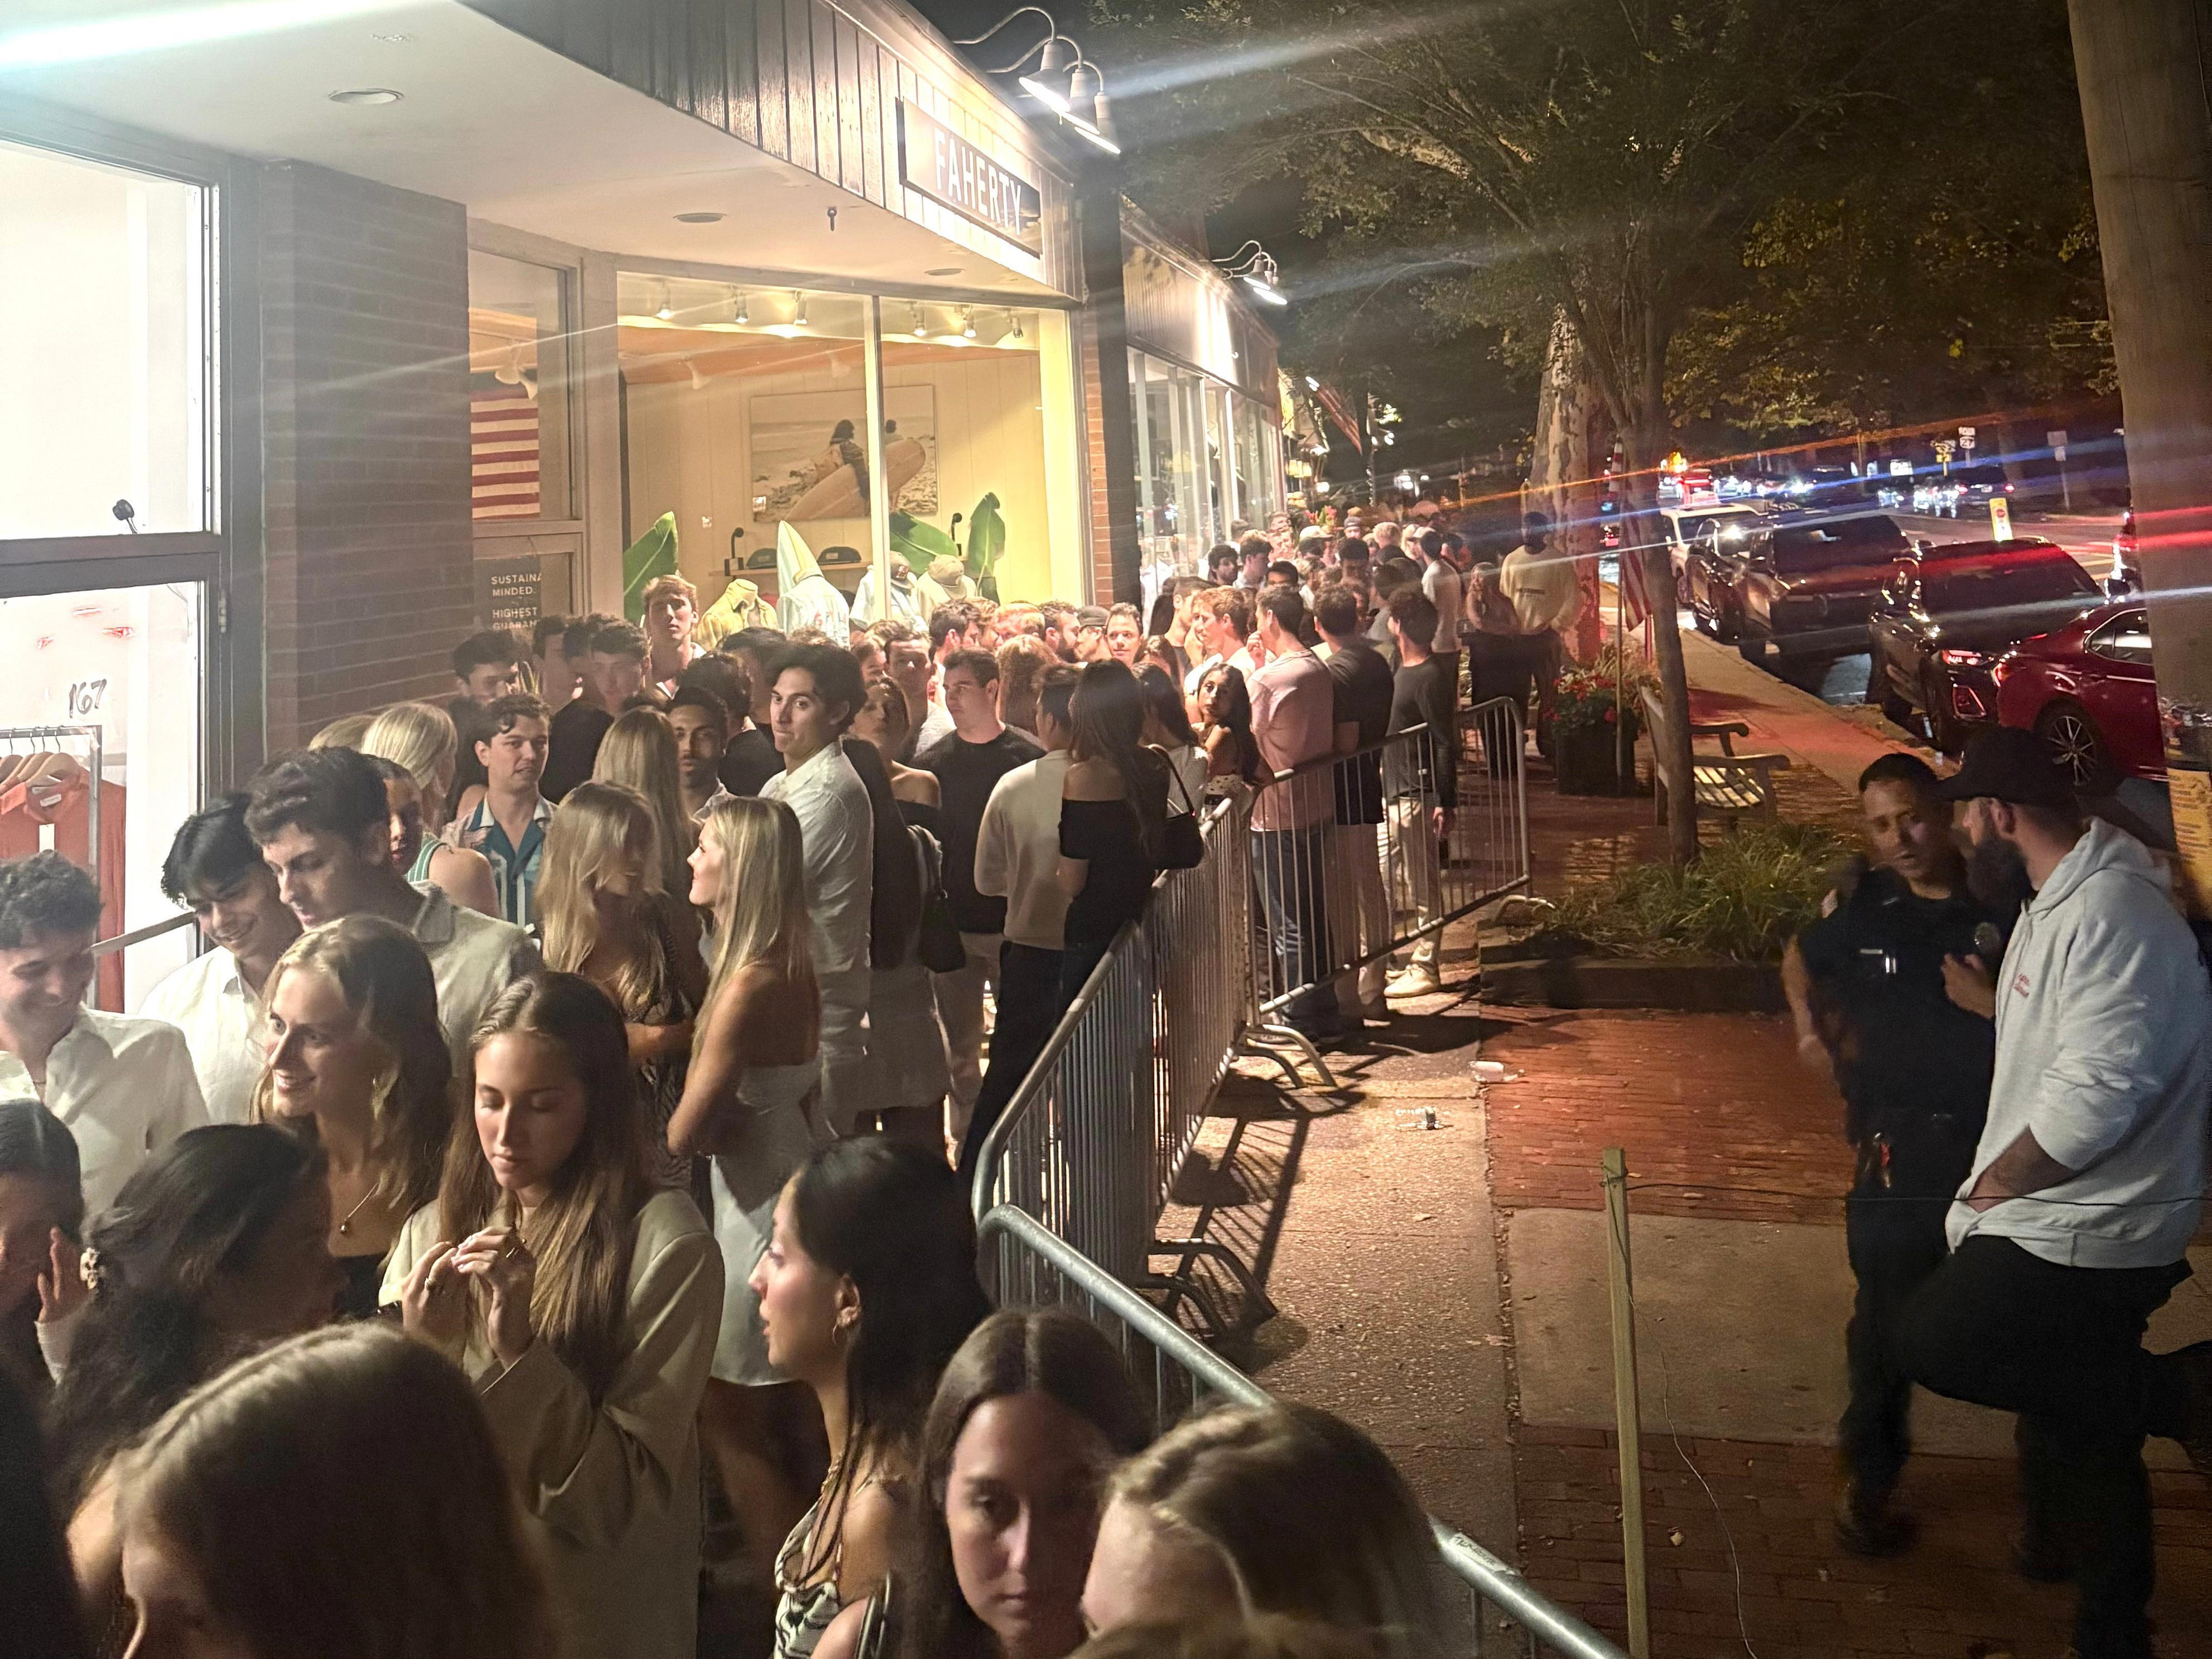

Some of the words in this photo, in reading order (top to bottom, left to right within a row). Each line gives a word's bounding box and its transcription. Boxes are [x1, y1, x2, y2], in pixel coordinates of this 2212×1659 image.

[934, 127, 1021, 236] FAHERTY
[1961, 438, 1974, 447] 27
[492, 607, 537, 619] HIGHEST
[493, 620, 540, 630] GUARAN
[69, 678, 107, 718] 167
